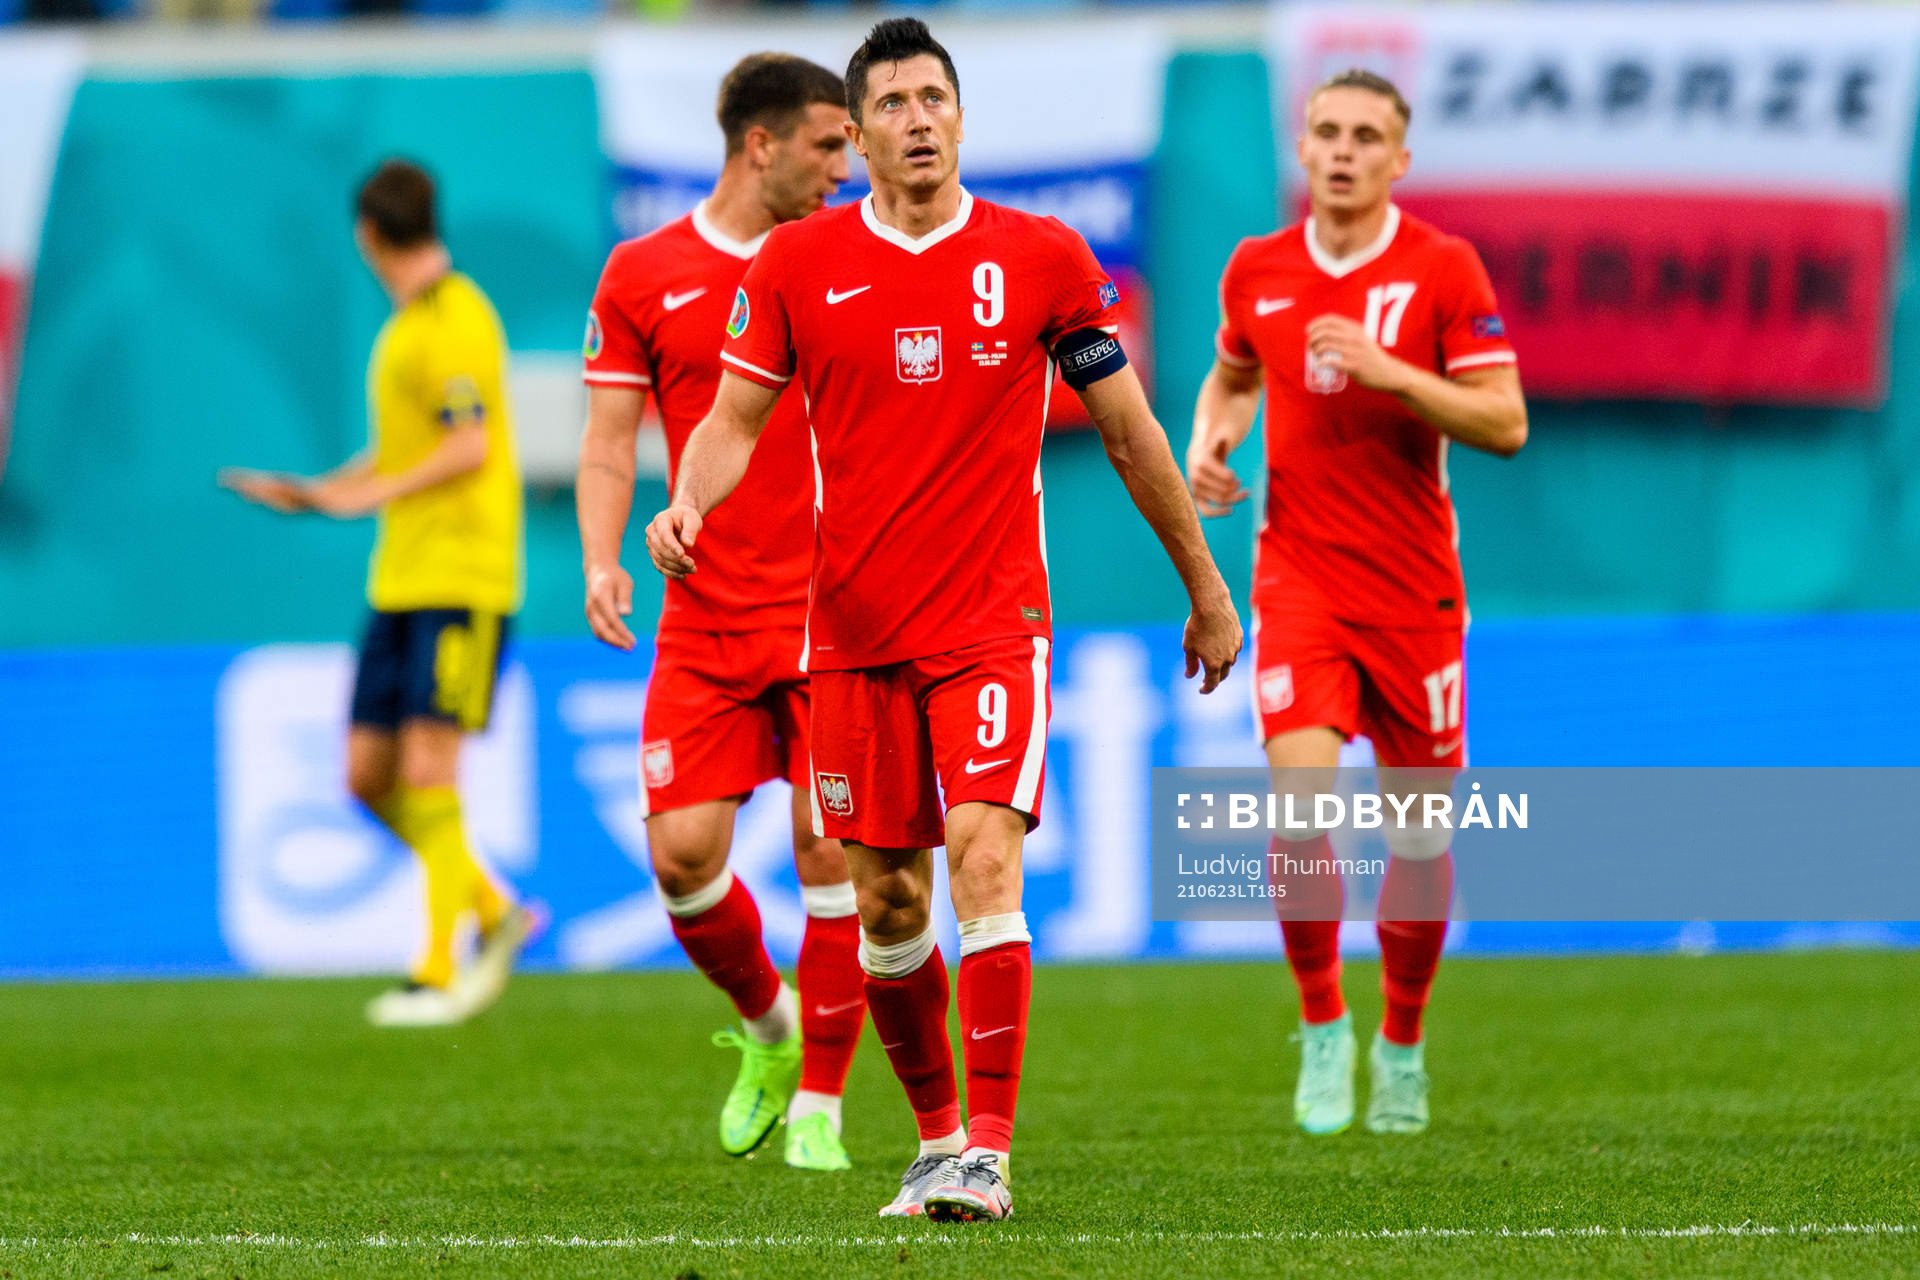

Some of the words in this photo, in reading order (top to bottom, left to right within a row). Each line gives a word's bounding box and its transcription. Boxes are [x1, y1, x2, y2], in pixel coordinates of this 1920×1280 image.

[972, 261, 1005, 327] 9
[1363, 281, 1417, 348] 17
[976, 682, 1008, 749] 9
[1423, 660, 1463, 733] 17
